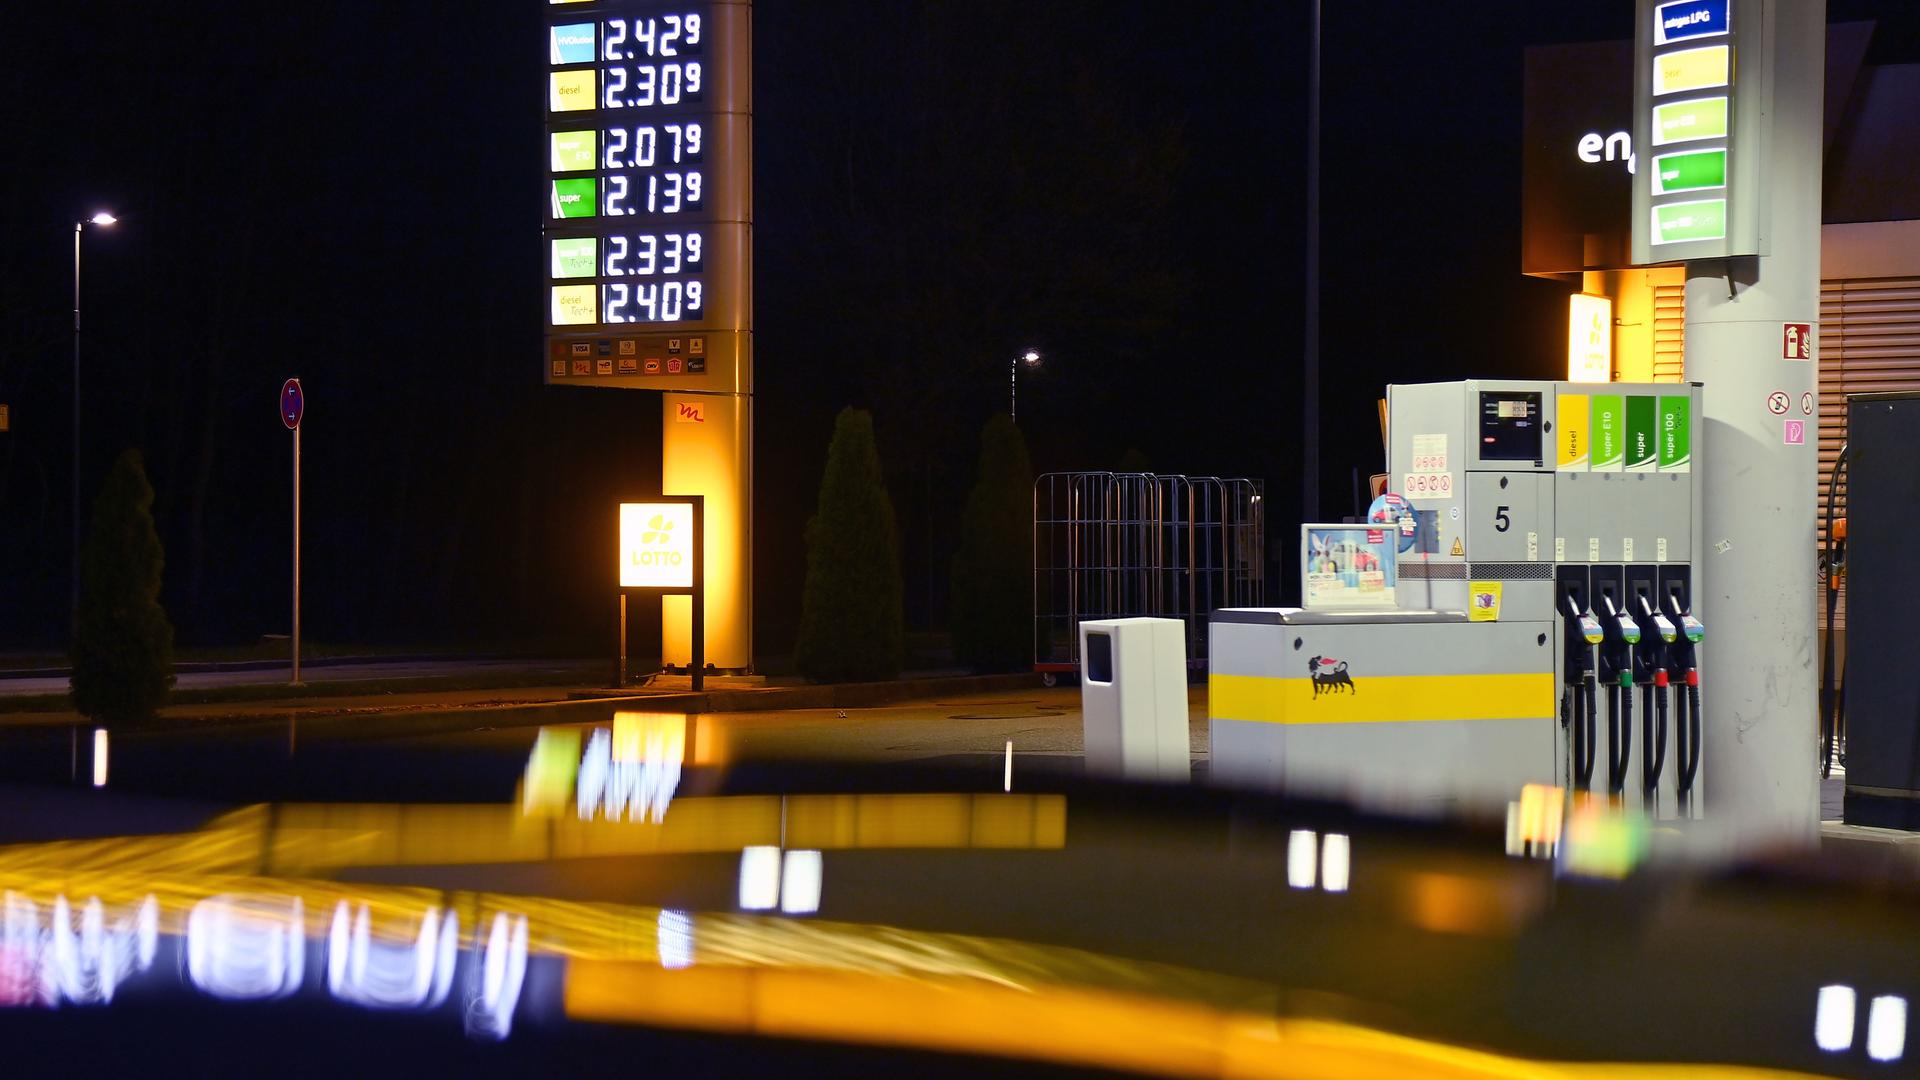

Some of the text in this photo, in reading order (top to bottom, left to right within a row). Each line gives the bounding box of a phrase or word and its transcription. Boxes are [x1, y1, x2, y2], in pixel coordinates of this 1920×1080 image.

[1690, 10, 1710, 24] LPG
[558, 85, 581, 96] diesel
[1578, 132, 1635, 175] en
[559, 193, 581, 204] super
[560, 295, 582, 305] diesel
[575, 344, 588, 352] VISA
[1568, 430, 1577, 457] diesel
[1603, 411, 1612, 457] super E10
[1665, 413, 1674, 459] super 100
[1637, 432, 1646, 458] super
[1495, 506, 1510, 533] 5
[632, 550, 682, 567] LOTTO
